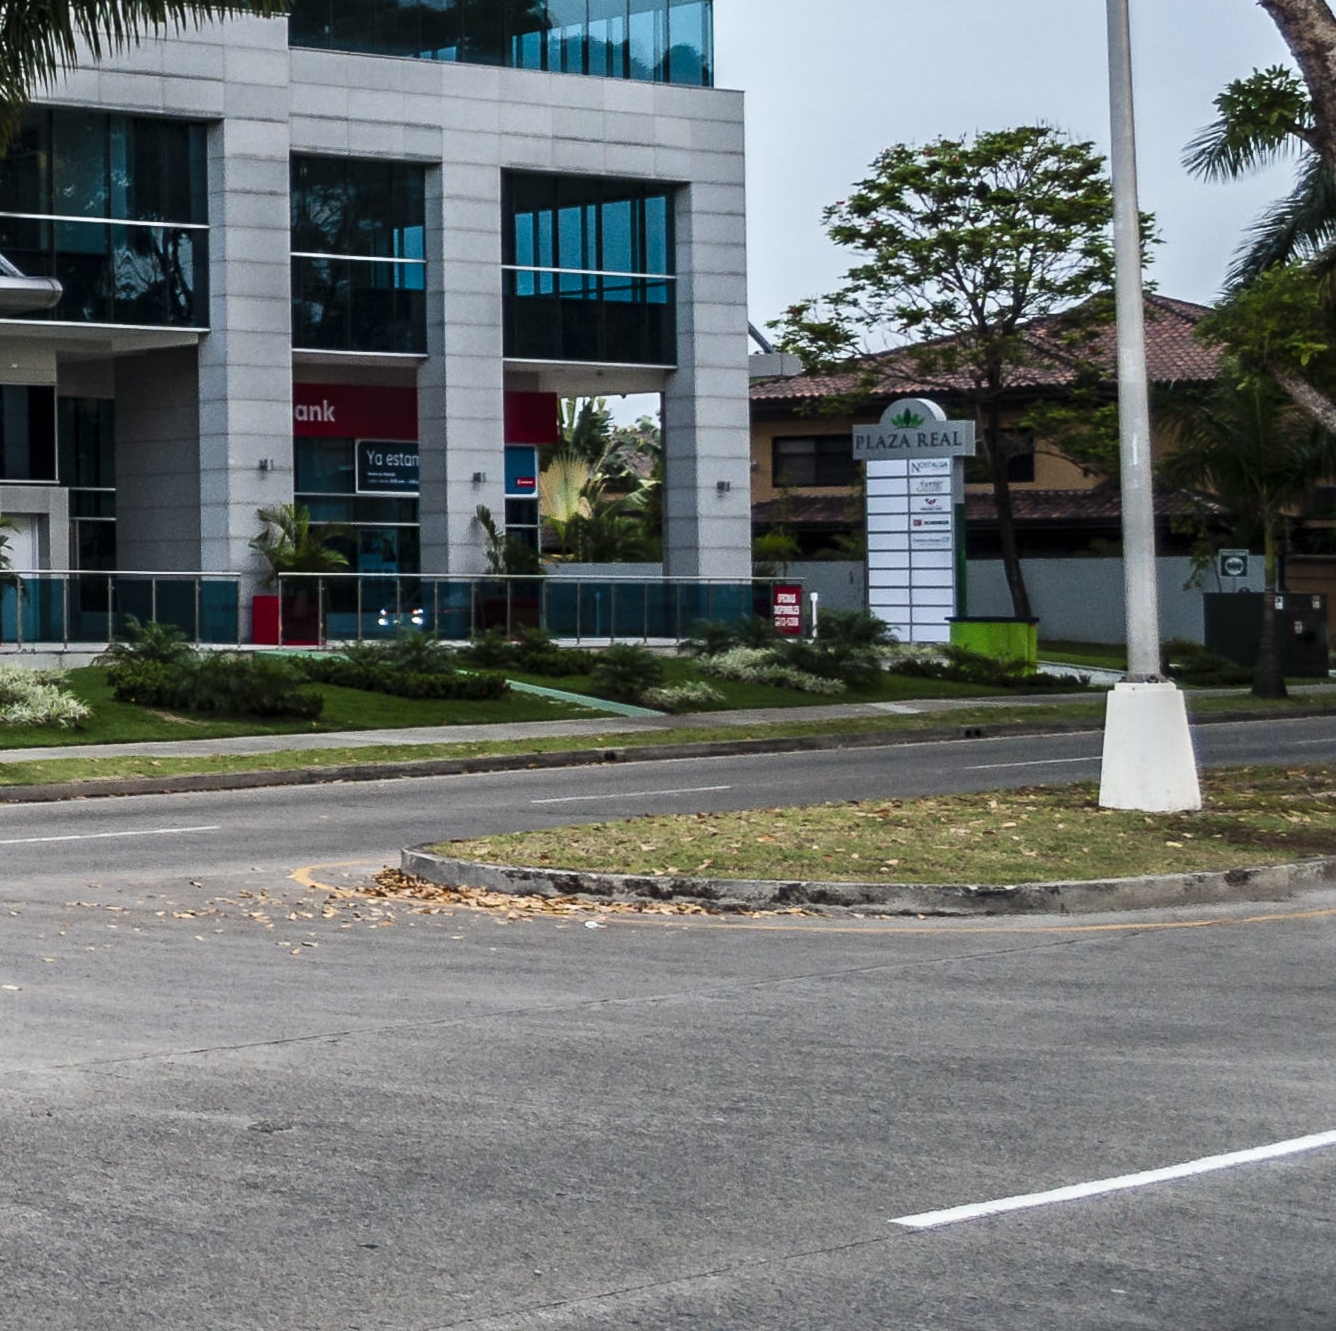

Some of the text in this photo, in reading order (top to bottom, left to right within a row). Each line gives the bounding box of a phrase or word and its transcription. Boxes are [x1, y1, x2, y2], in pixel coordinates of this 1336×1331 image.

[294, 400, 336, 422] ank
[855, 431, 963, 450] PLAZA REAL
[367, 450, 383, 466] Ya
